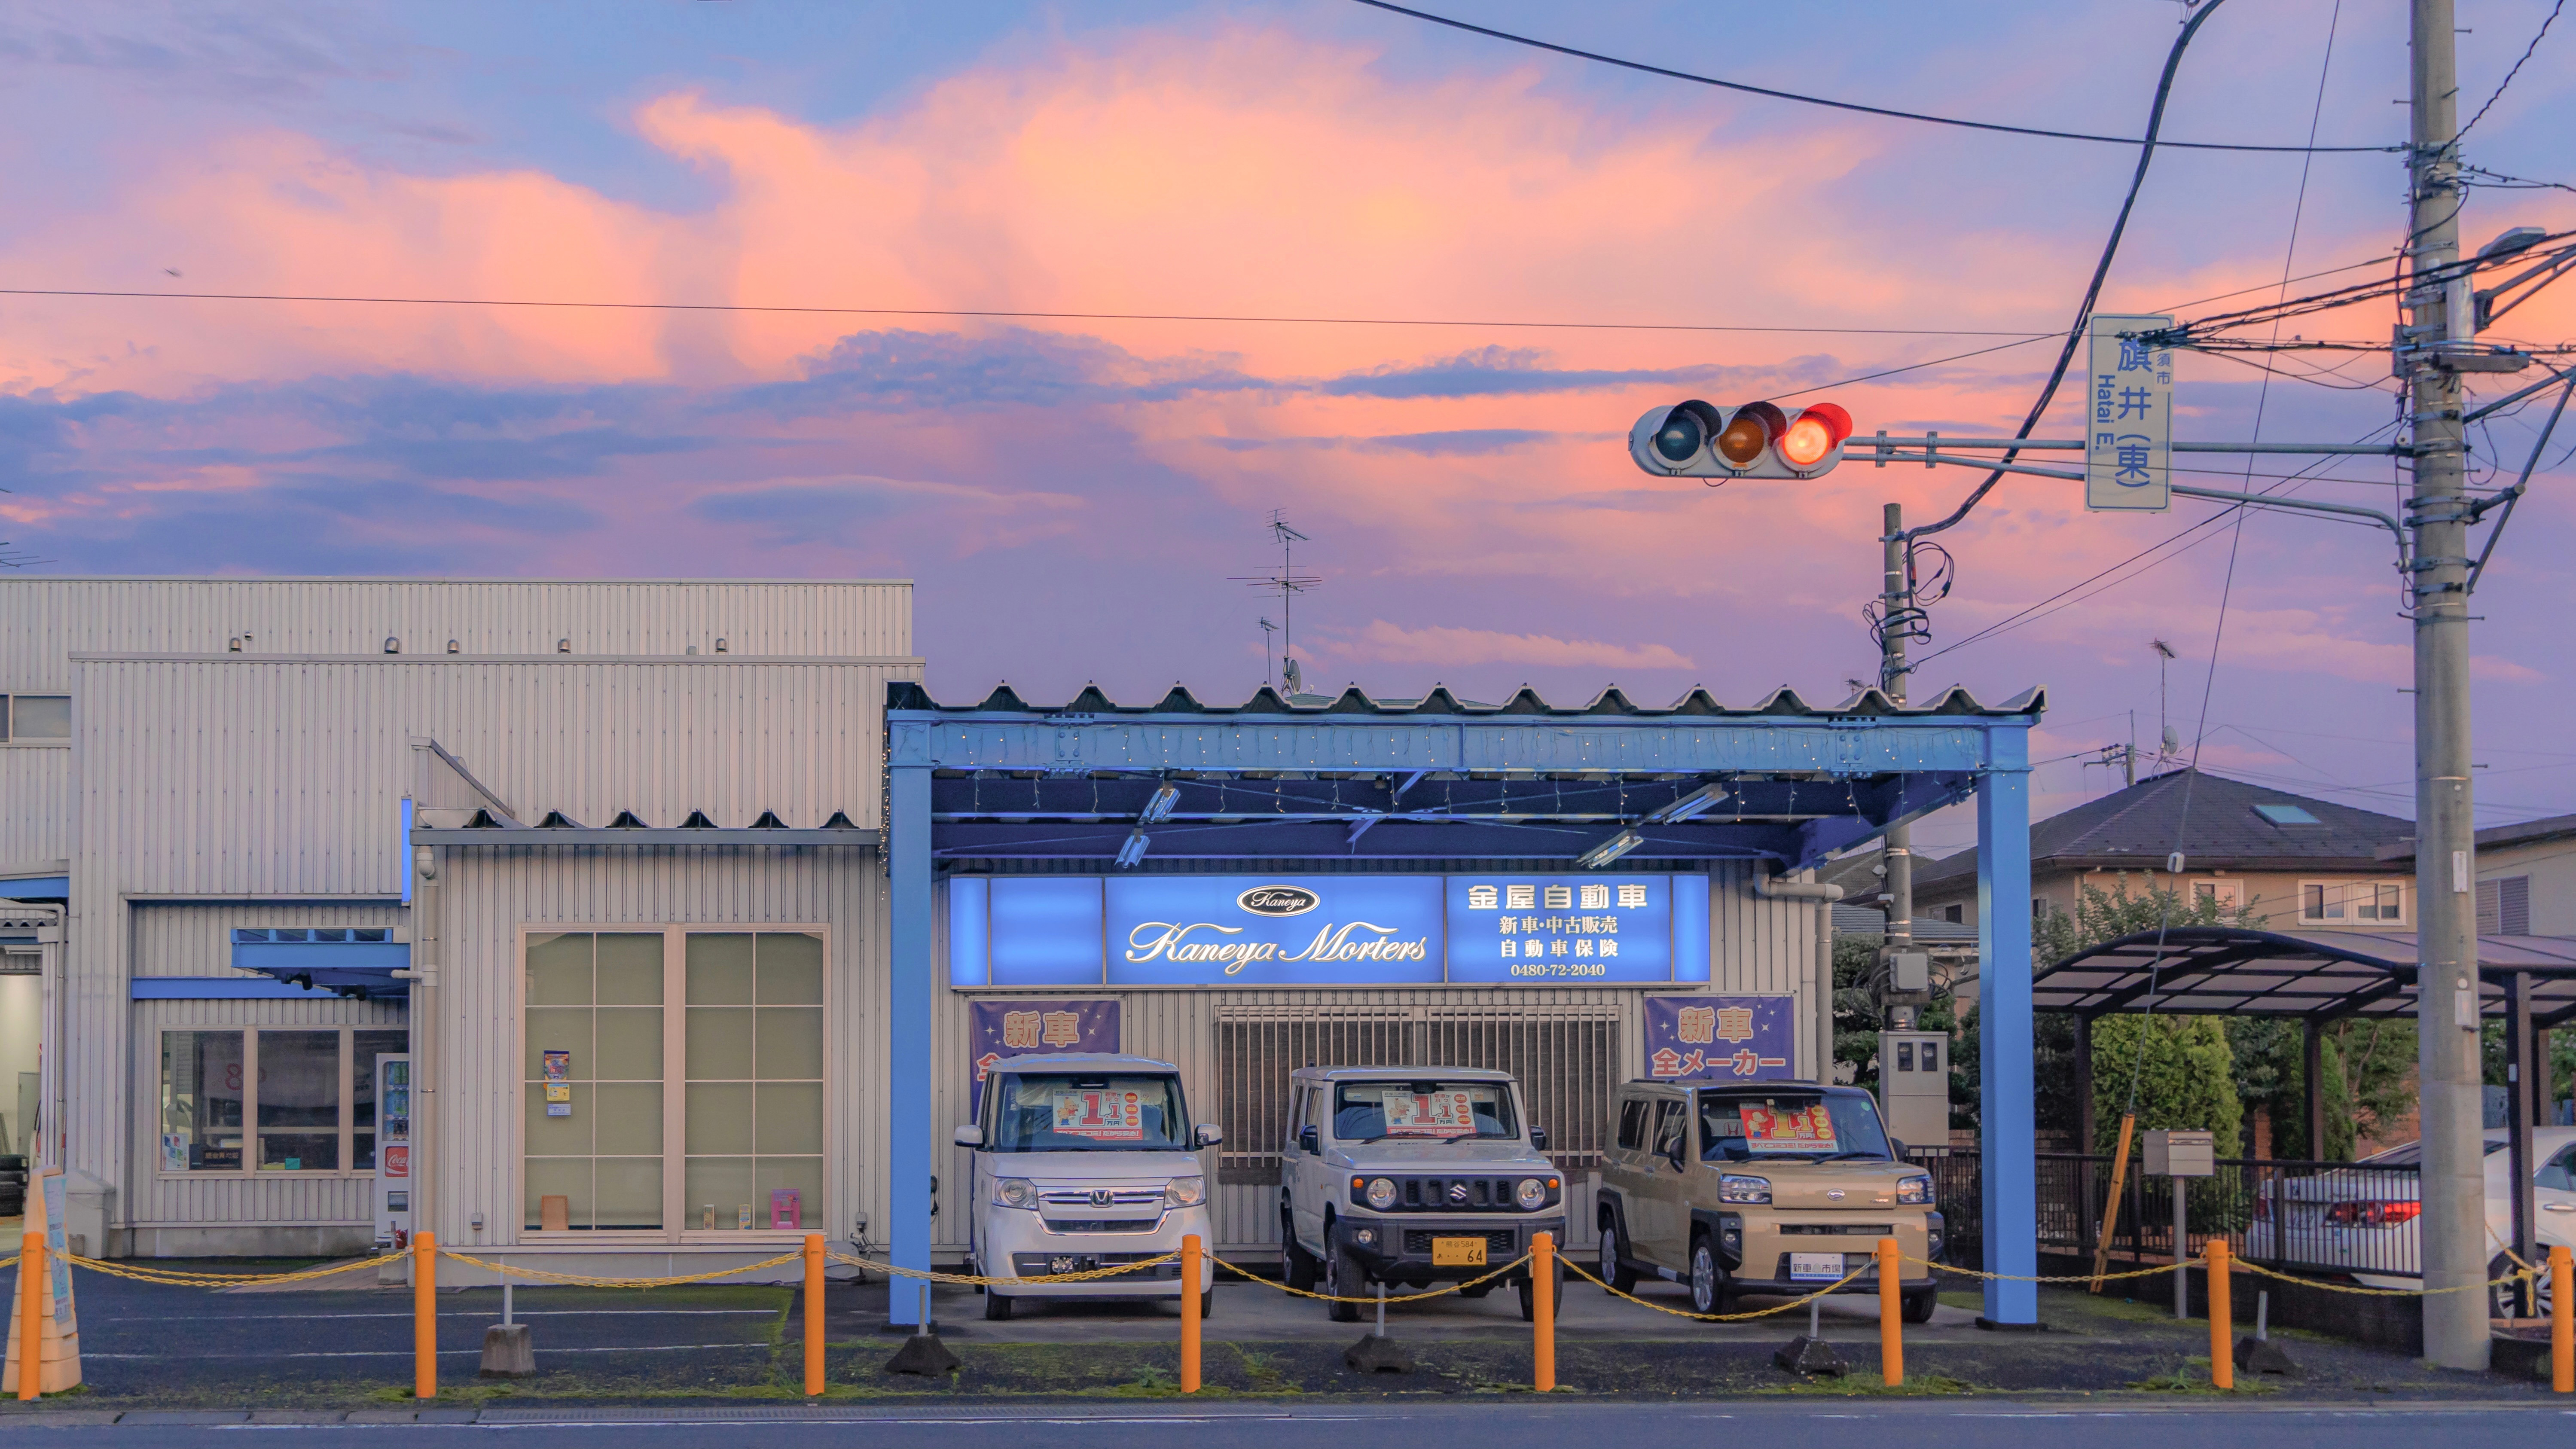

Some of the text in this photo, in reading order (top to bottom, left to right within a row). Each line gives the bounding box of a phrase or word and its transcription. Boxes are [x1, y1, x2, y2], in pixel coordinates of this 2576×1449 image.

[2096, 375, 2115, 450] Hatai E.
[1251, 891, 1306, 911] Kaneya
[1468, 885, 1648, 909] 金屋自動車
[1499, 916, 1618, 934] 新車・中古販売
[1125, 921, 1427, 976] Kaneya Morters
[1501, 939, 1618, 958] 自動車保険
[1511, 964, 1605, 977] 0480-72-2040
[1003, 1010, 1080, 1048] 新車
[1678, 1007, 1754, 1044] 新車
[1651, 1049, 1786, 1077] 全メーカー
